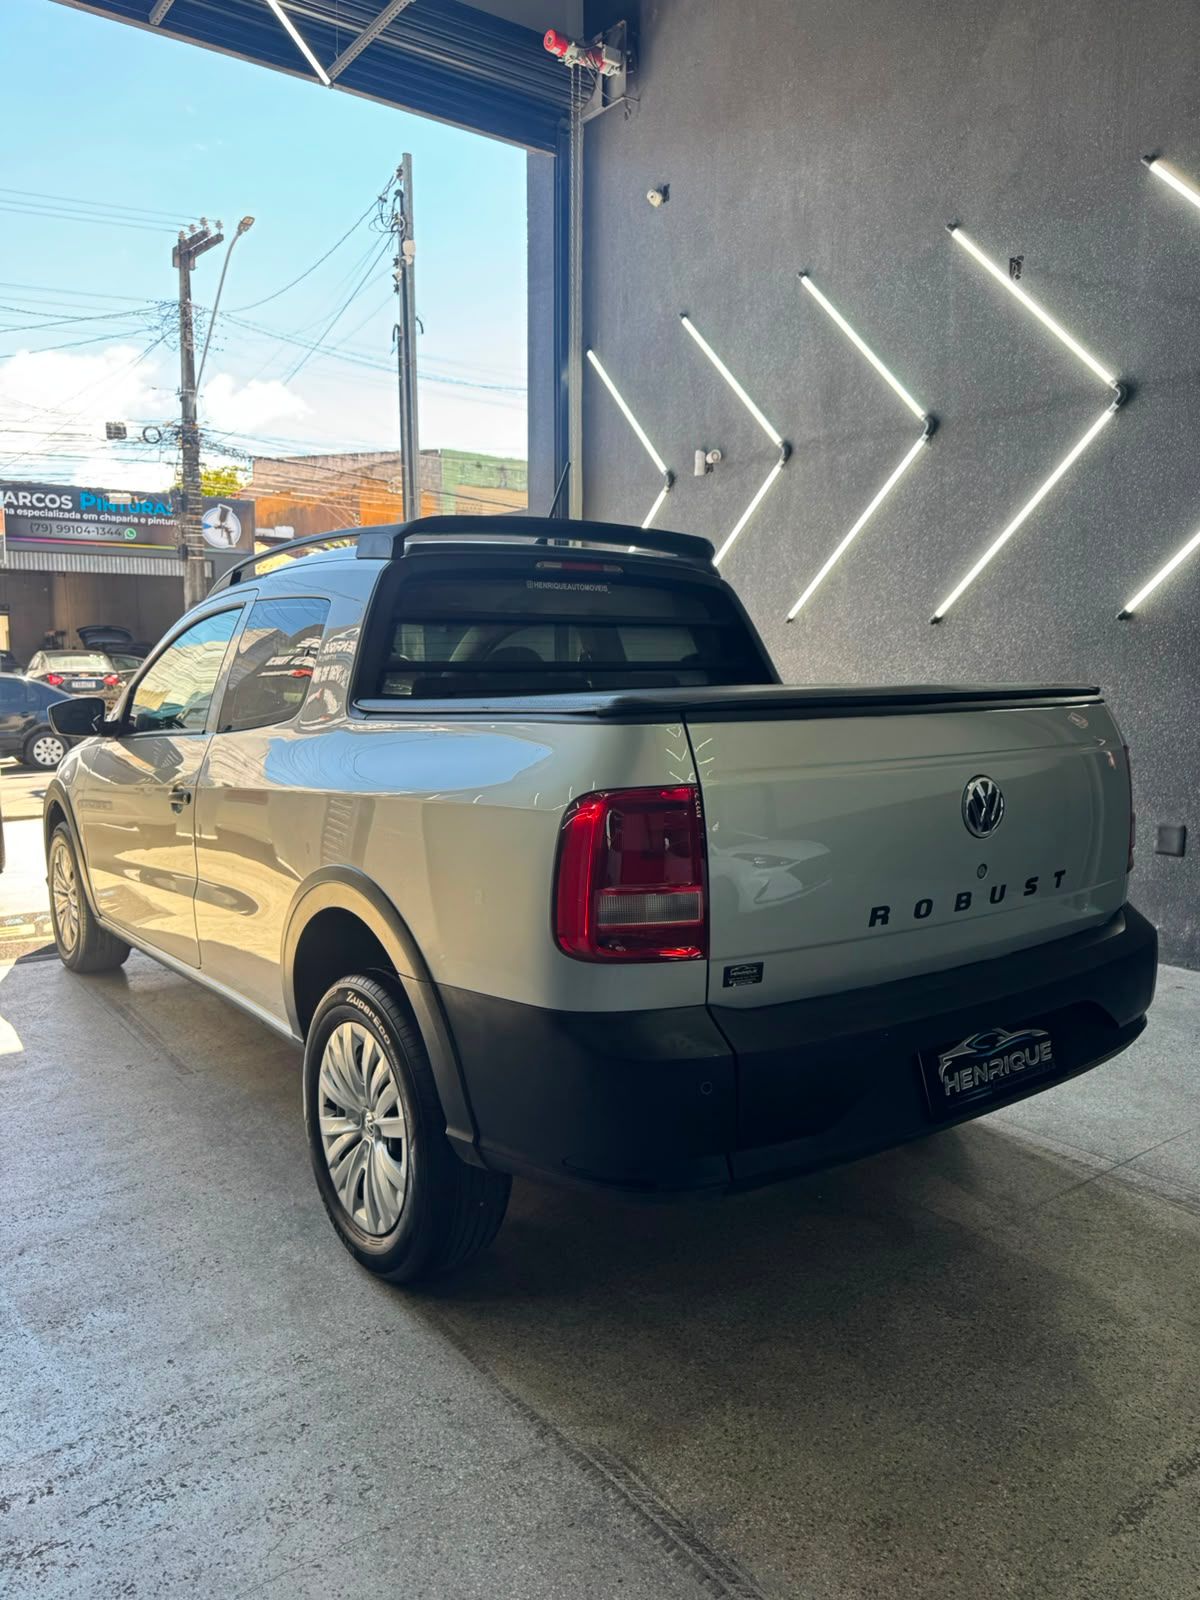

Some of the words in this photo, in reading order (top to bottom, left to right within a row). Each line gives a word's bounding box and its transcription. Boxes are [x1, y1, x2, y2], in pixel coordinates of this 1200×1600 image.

[16, 508, 81, 520] especializada
[82, 513, 98, 521] em
[99, 513, 138, 524] chaparia
[148, 516, 177, 526] pintur
[30, 522, 52, 535] (79)
[56, 524, 122, 537] 99104-1344
[868, 869, 1066, 928] ROBUST
[944, 1040, 1053, 1096] HENRIQUE
